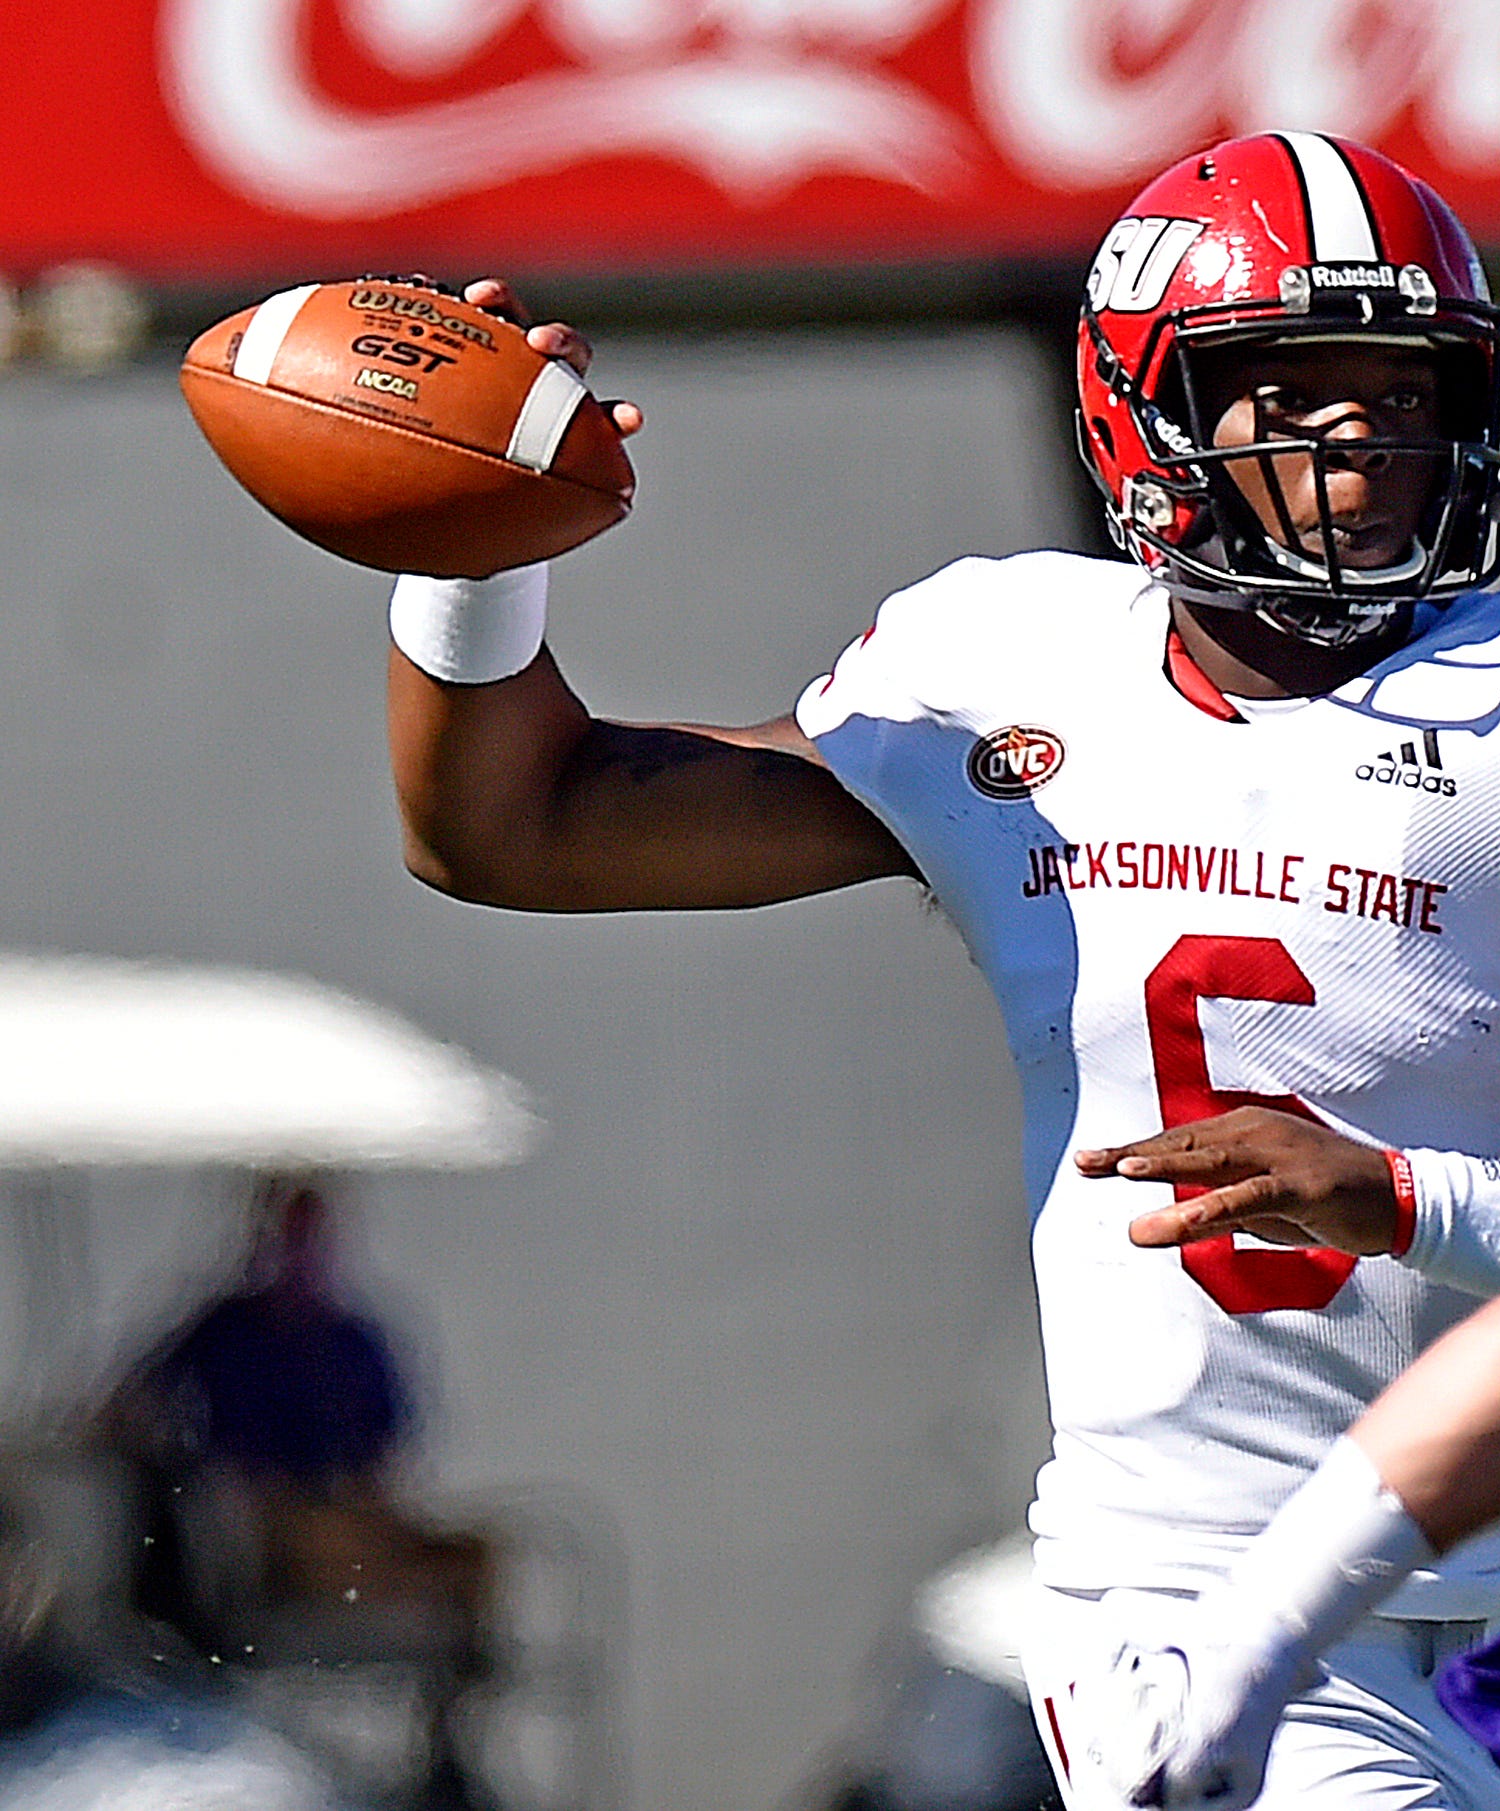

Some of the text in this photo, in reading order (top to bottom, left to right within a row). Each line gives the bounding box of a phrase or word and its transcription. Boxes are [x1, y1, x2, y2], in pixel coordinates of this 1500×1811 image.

[1310, 264, 1397, 289] Riddell
[348, 289, 498, 352] Wilson
[351, 334, 458, 374] GST
[355, 368, 418, 403] NCAA
[988, 742, 1049, 778] OVC
[1355, 757, 1458, 798] adidas
[1022, 840, 1449, 936] JACKSONVILLE STATE
[1144, 933, 1360, 1315] 6
